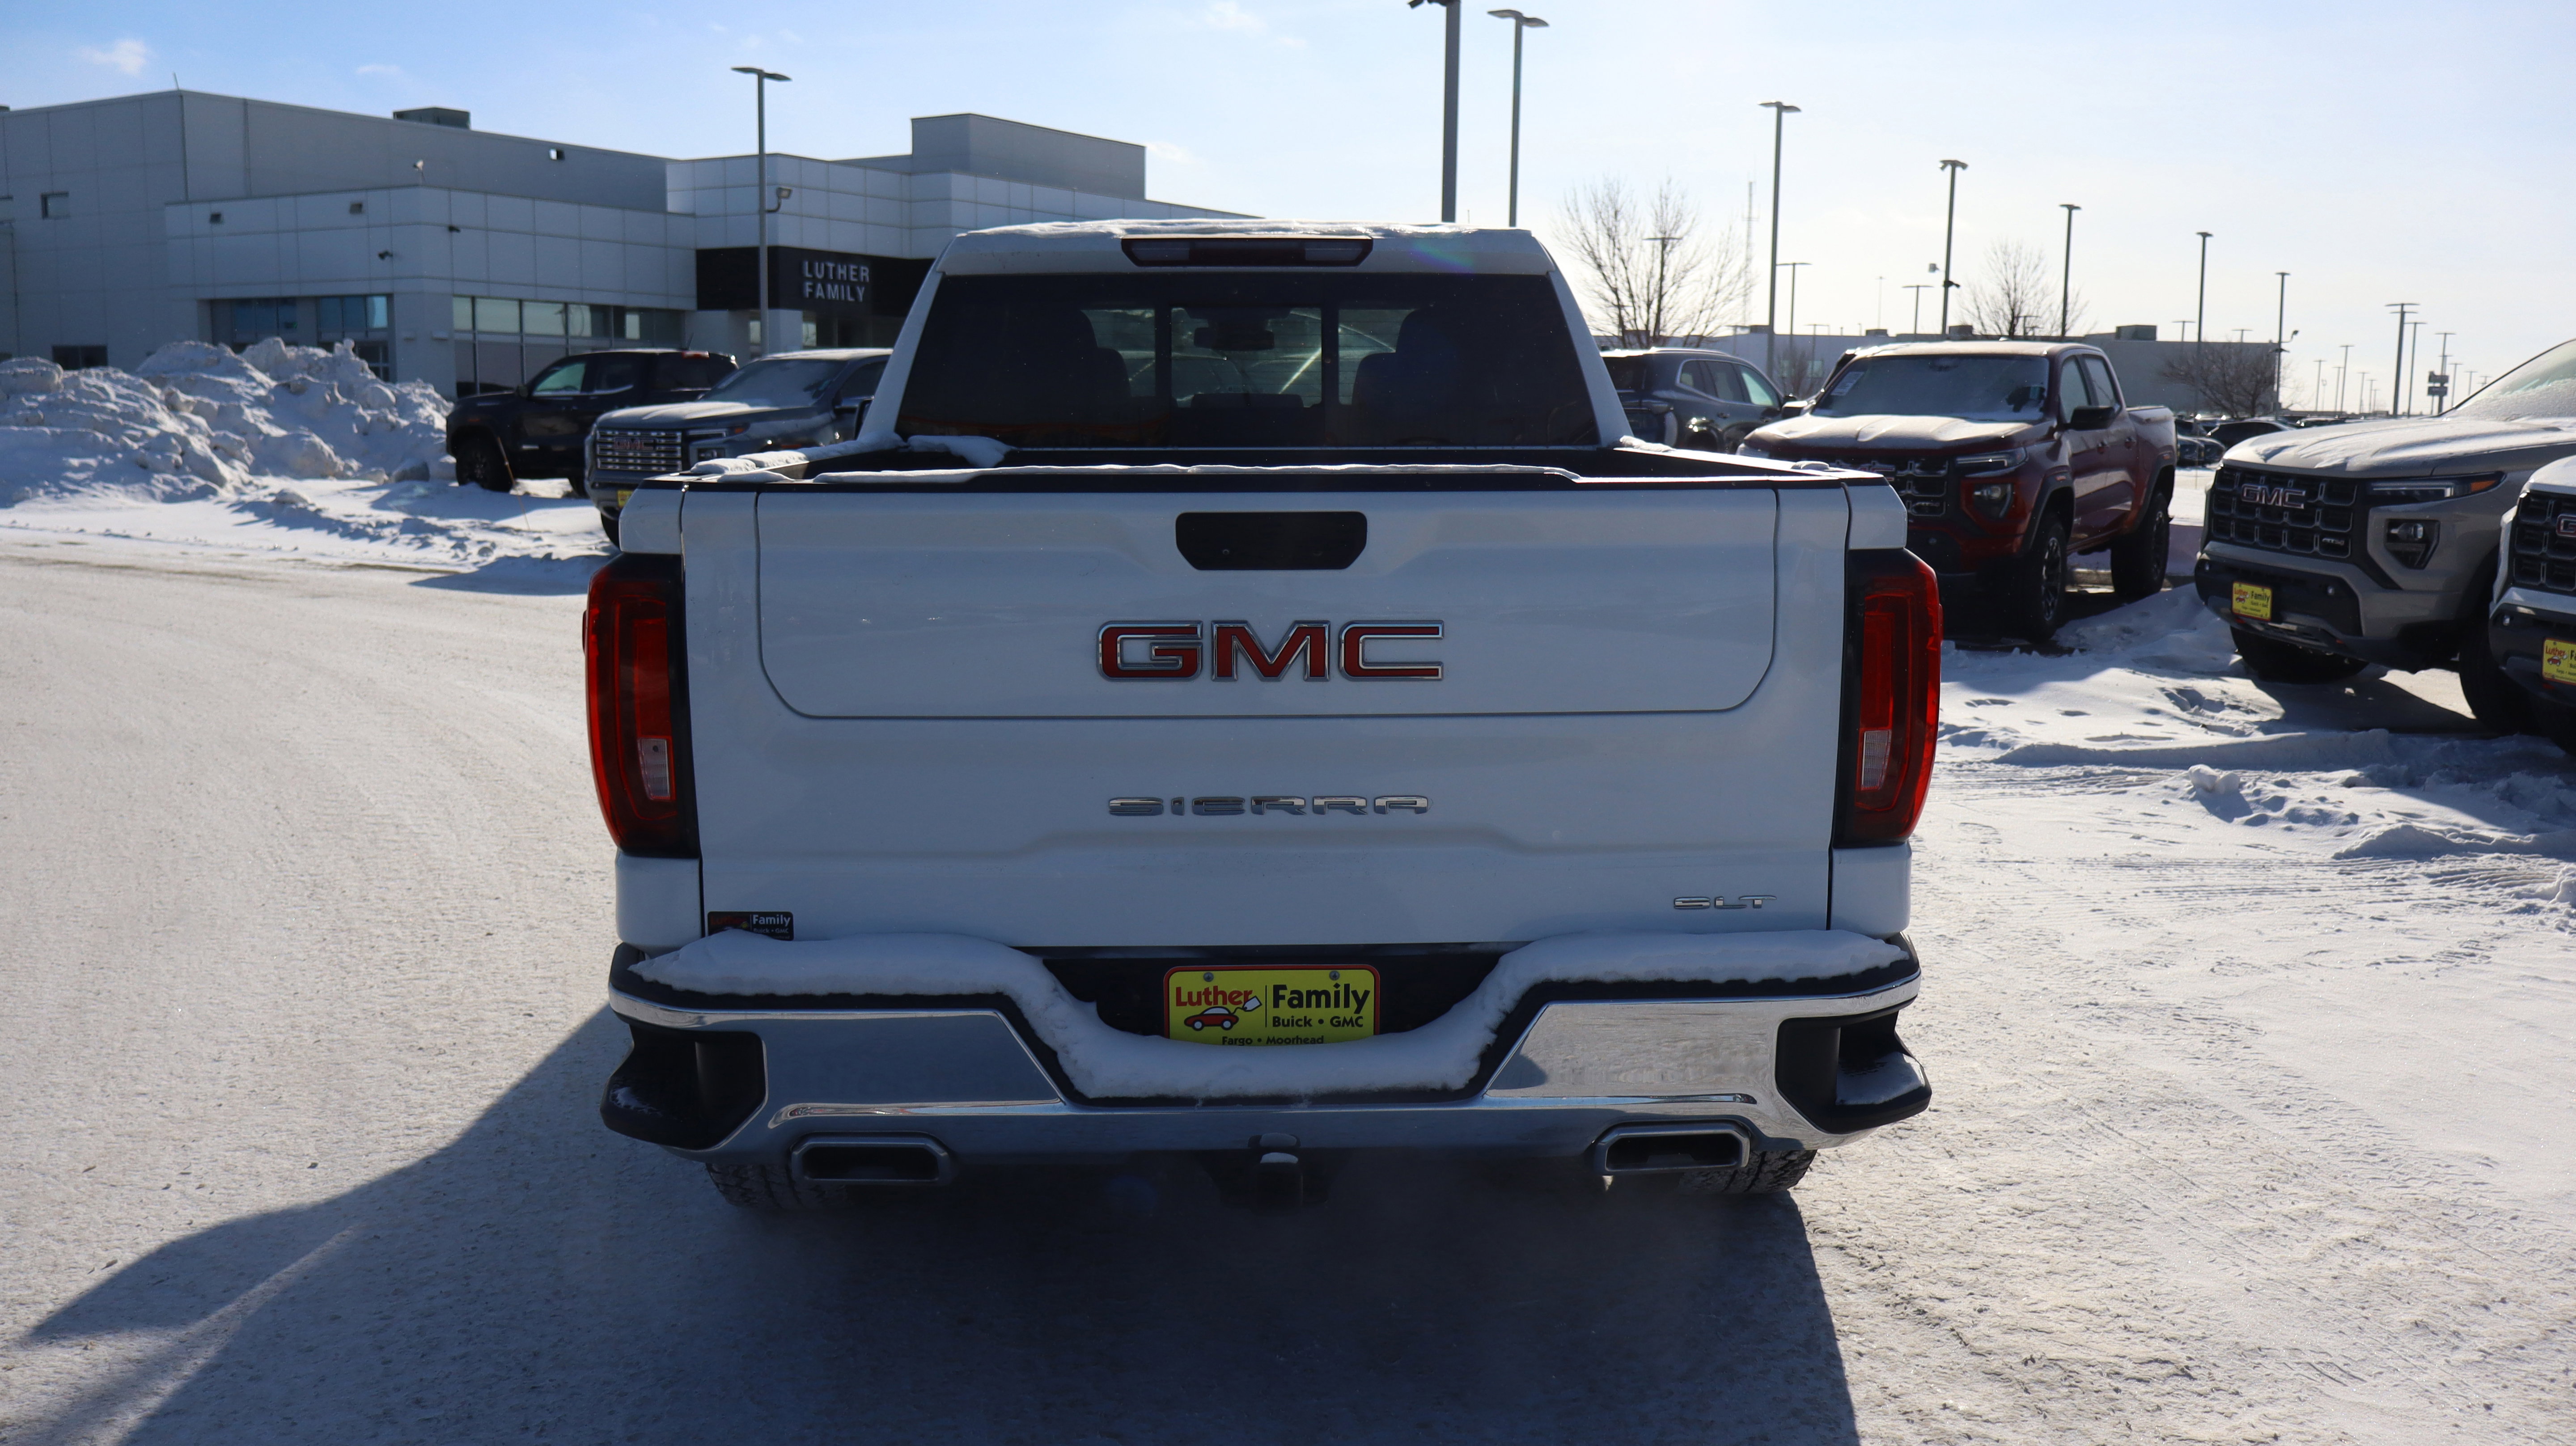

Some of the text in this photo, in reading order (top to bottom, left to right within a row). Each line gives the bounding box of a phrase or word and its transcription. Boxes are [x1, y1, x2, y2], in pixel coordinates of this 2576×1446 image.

[803, 260, 869, 282] LUTHER
[803, 281, 865, 302] FAMILY
[2242, 483, 2306, 509] GMC
[1096, 620, 1445, 682] GMC
[1109, 796, 1429, 816] SIERRA
[1674, 895, 1777, 910] SLT
[753, 914, 791, 926] Family
[1175, 983, 1370, 1014] Luther Family
[1272, 1016, 1364, 1027] Buick GMC
[1222, 1035, 1324, 1046] Fargo Moorhead
